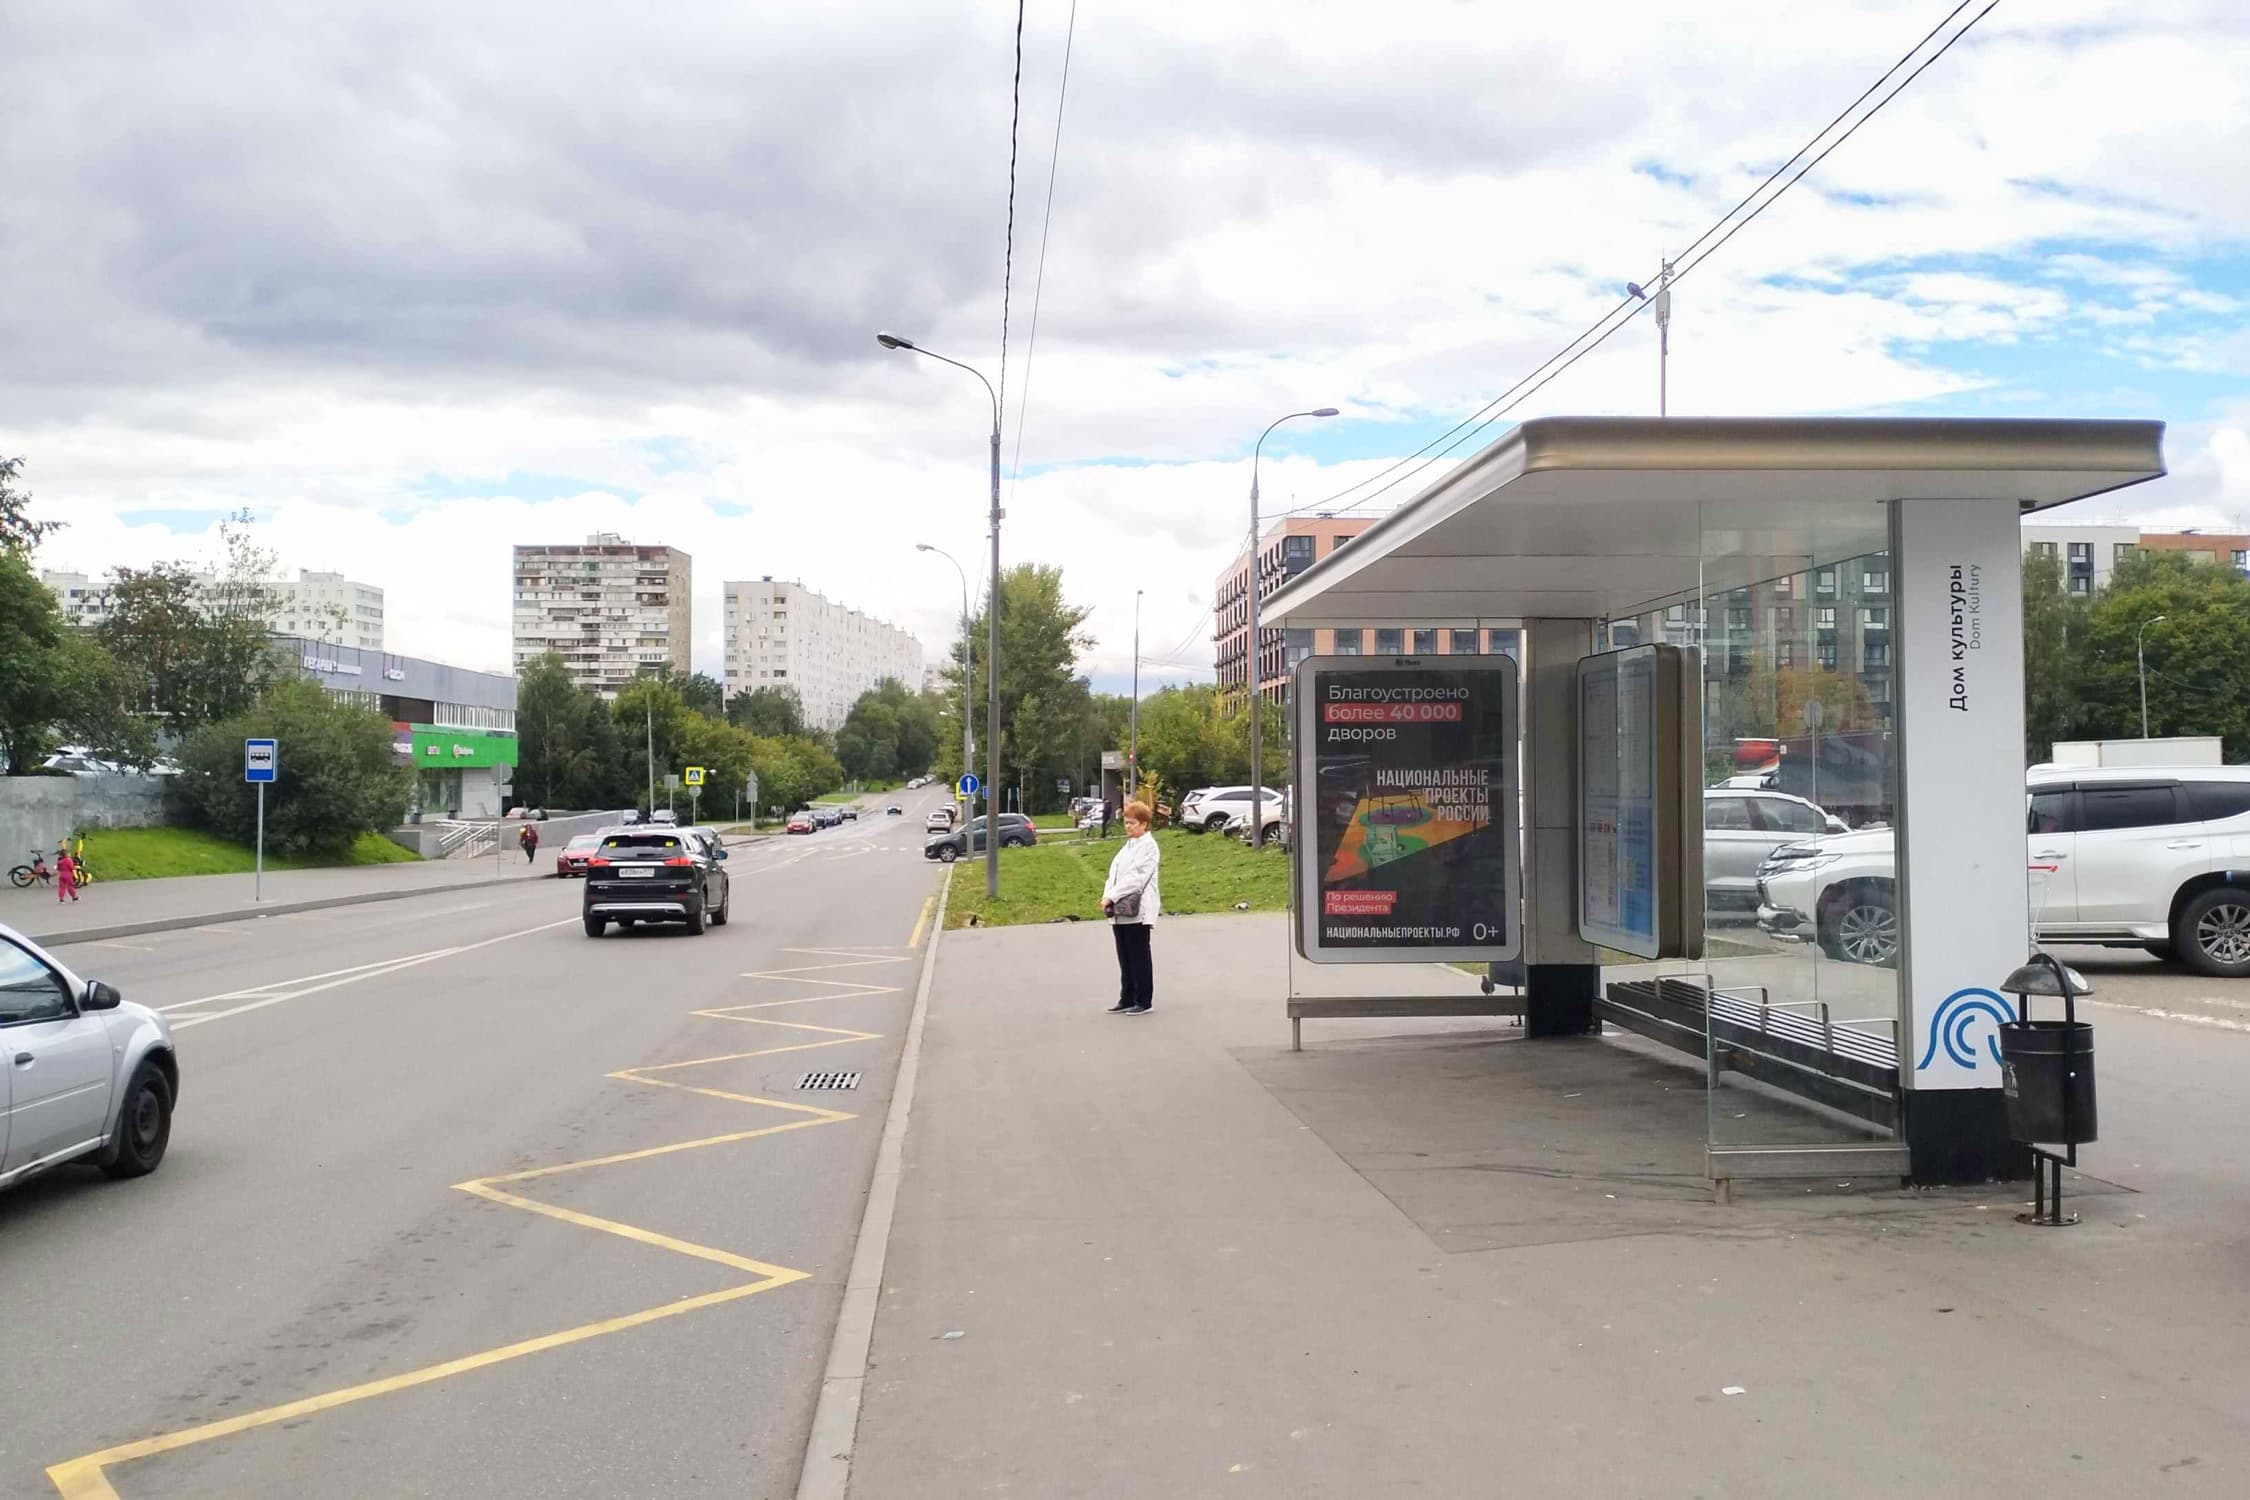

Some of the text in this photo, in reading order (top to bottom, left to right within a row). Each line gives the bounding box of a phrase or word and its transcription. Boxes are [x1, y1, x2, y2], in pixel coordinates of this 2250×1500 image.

[1968, 564, 1982, 650] Dom Kultury
[1949, 565, 1969, 712] Дом культуры
[1328, 684, 1470, 703] Благоустроено
[1328, 704, 1457, 720] более 40 000
[1327, 727, 1397, 743] дворов
[1376, 769, 1489, 787] НАЦИОНАЛЬНЫЕ
[1425, 787, 1489, 804] ПРОЕКТЫ
[1437, 804, 1490, 821] РОССИИ
[1326, 891, 1393, 903] По решению
[1326, 902, 1390, 914] Президента
[1326, 926, 1460, 939] НАЦИОНАЛЬНЫЕПРОЕКТЫ.РФ
[1472, 922, 1500, 941] 0+
